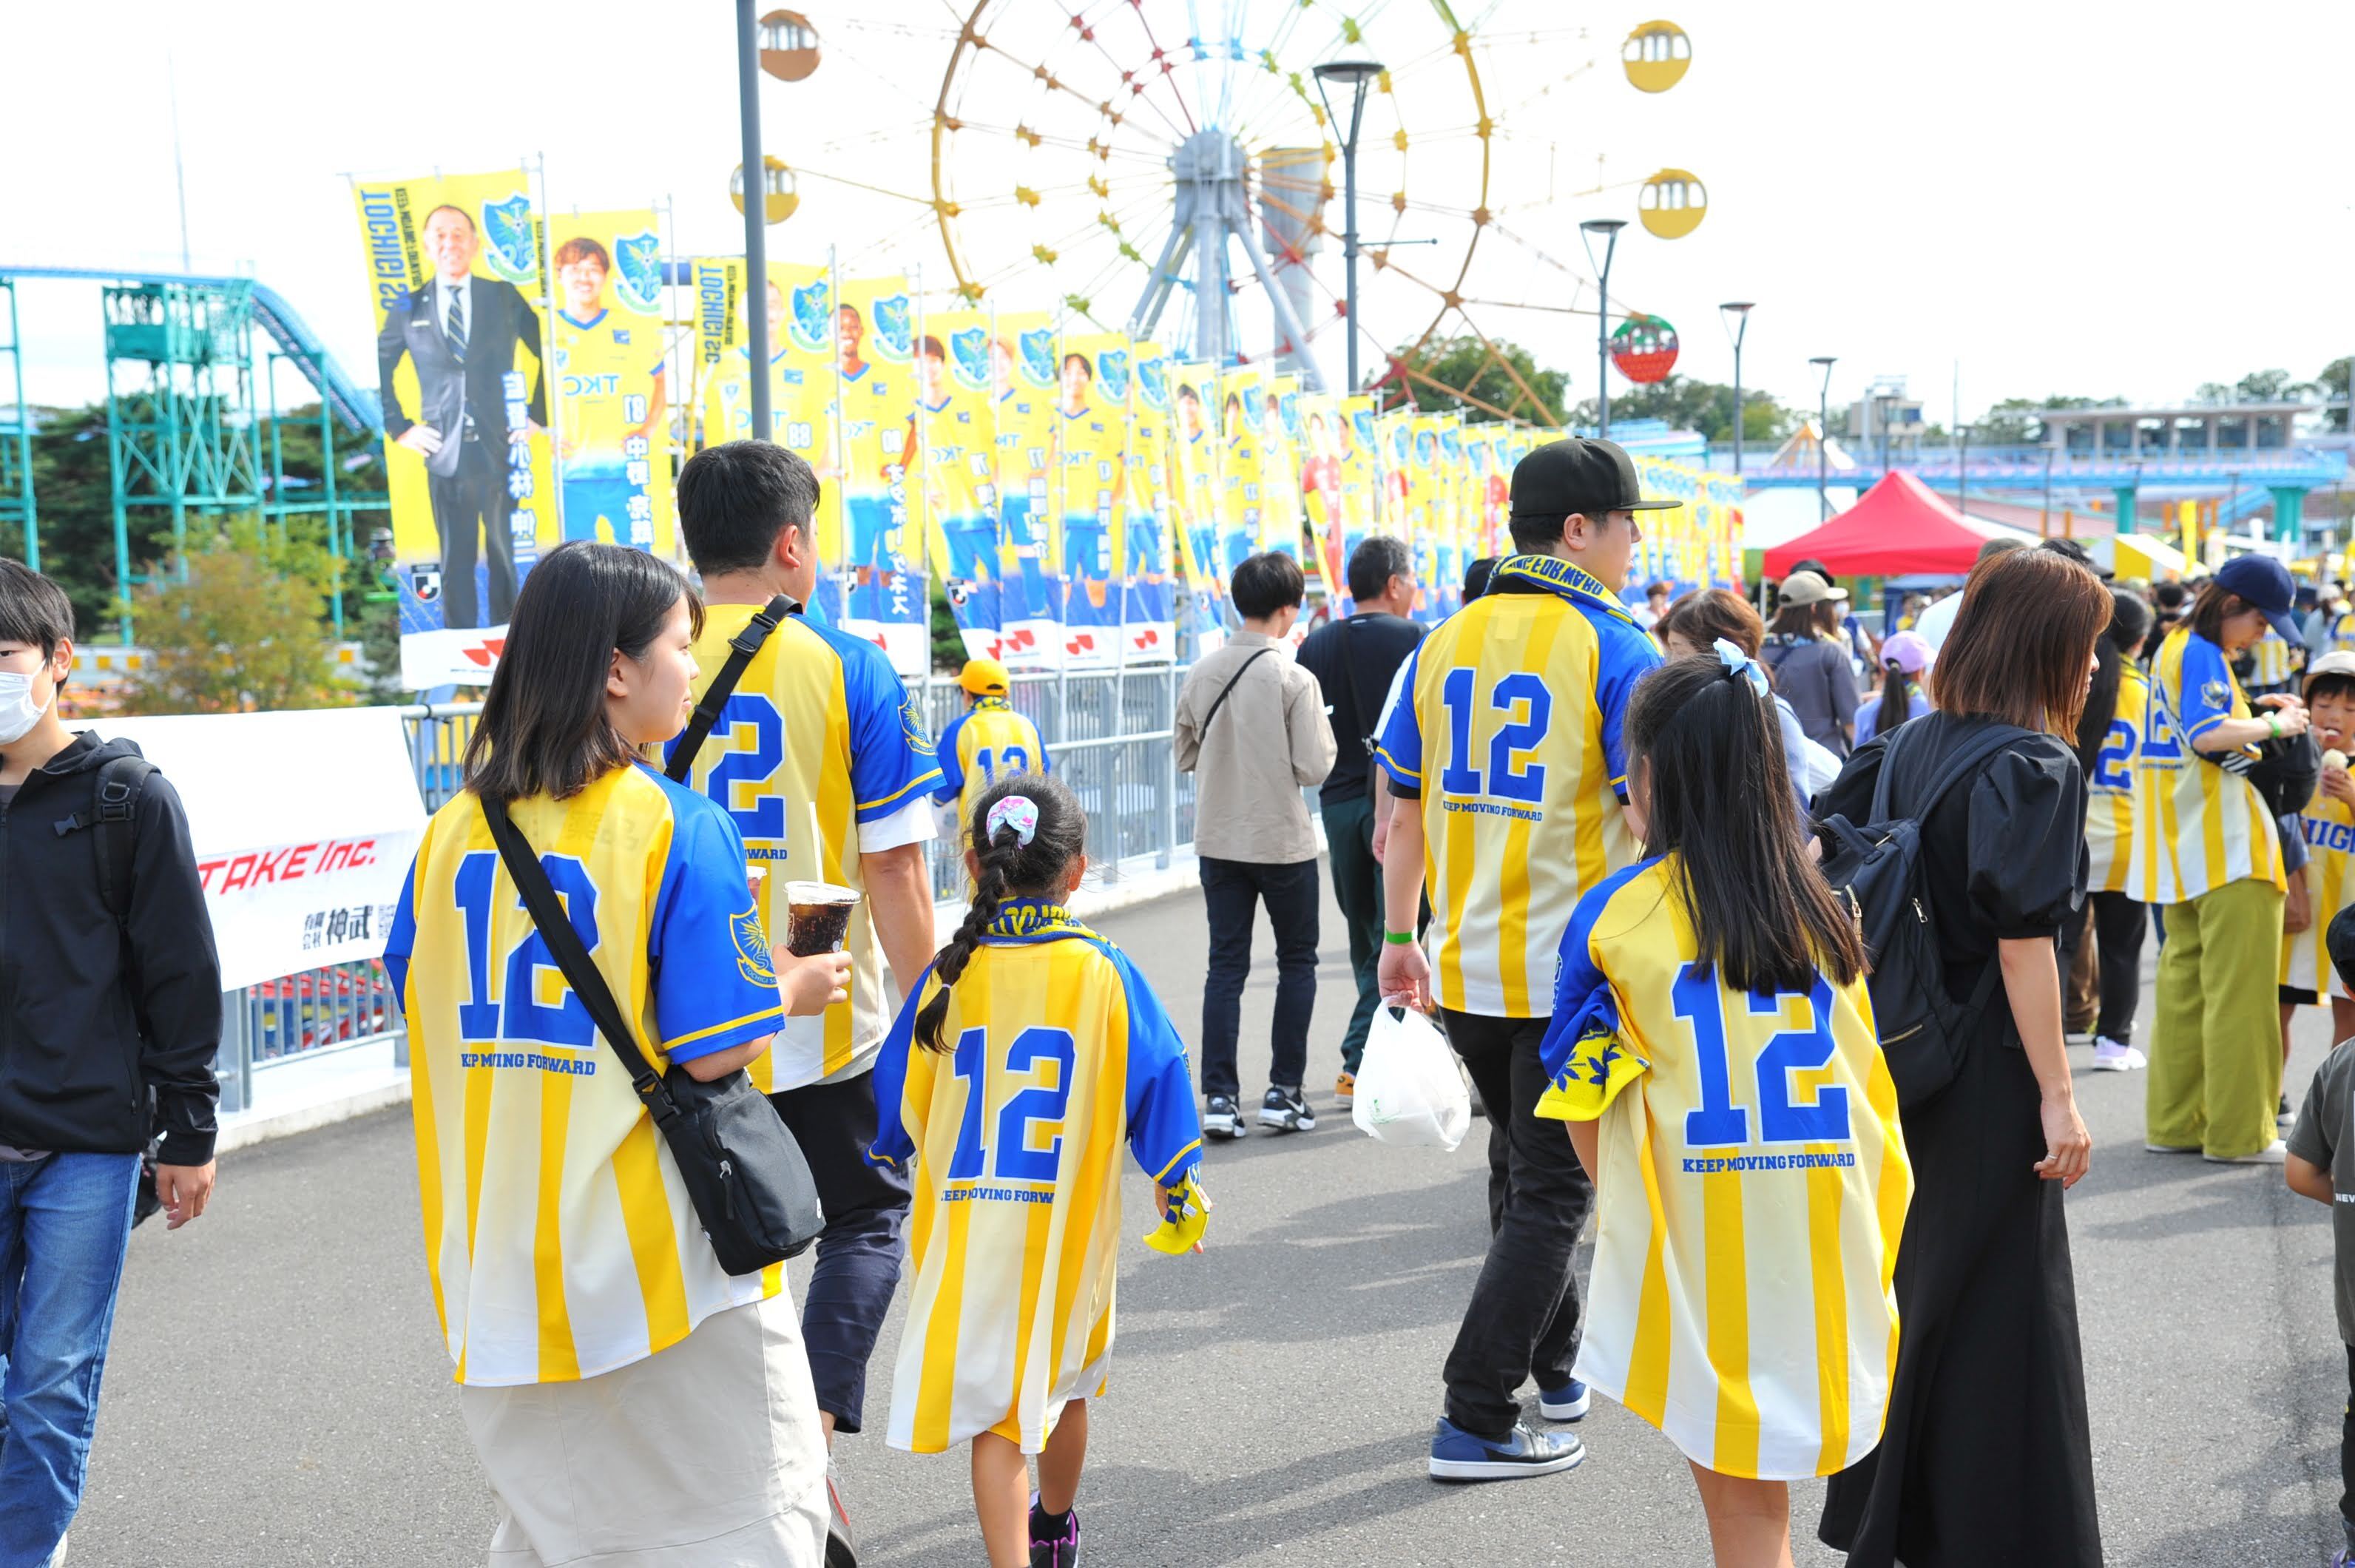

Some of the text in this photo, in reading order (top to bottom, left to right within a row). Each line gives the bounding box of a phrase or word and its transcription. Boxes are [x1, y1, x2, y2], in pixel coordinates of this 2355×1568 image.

[1441, 666, 1554, 804] 12
[682, 692, 787, 841] 2
[976, 743, 1029, 786] 12
[1462, 802, 1501, 814] MOVING
[1501, 806, 1543, 822] FORWARD
[314, 840, 376, 874] Inc.
[453, 849, 602, 1051] 12
[527, 1053, 597, 1076] FORWARD
[1669, 960, 1854, 1149] 12
[946, 1024, 1078, 1183] 12
[1682, 1152, 1856, 1172] KEEP MOVING FORWARD
[941, 1189, 967, 1202] EEP
[967, 1187, 1013, 1202] OVING
